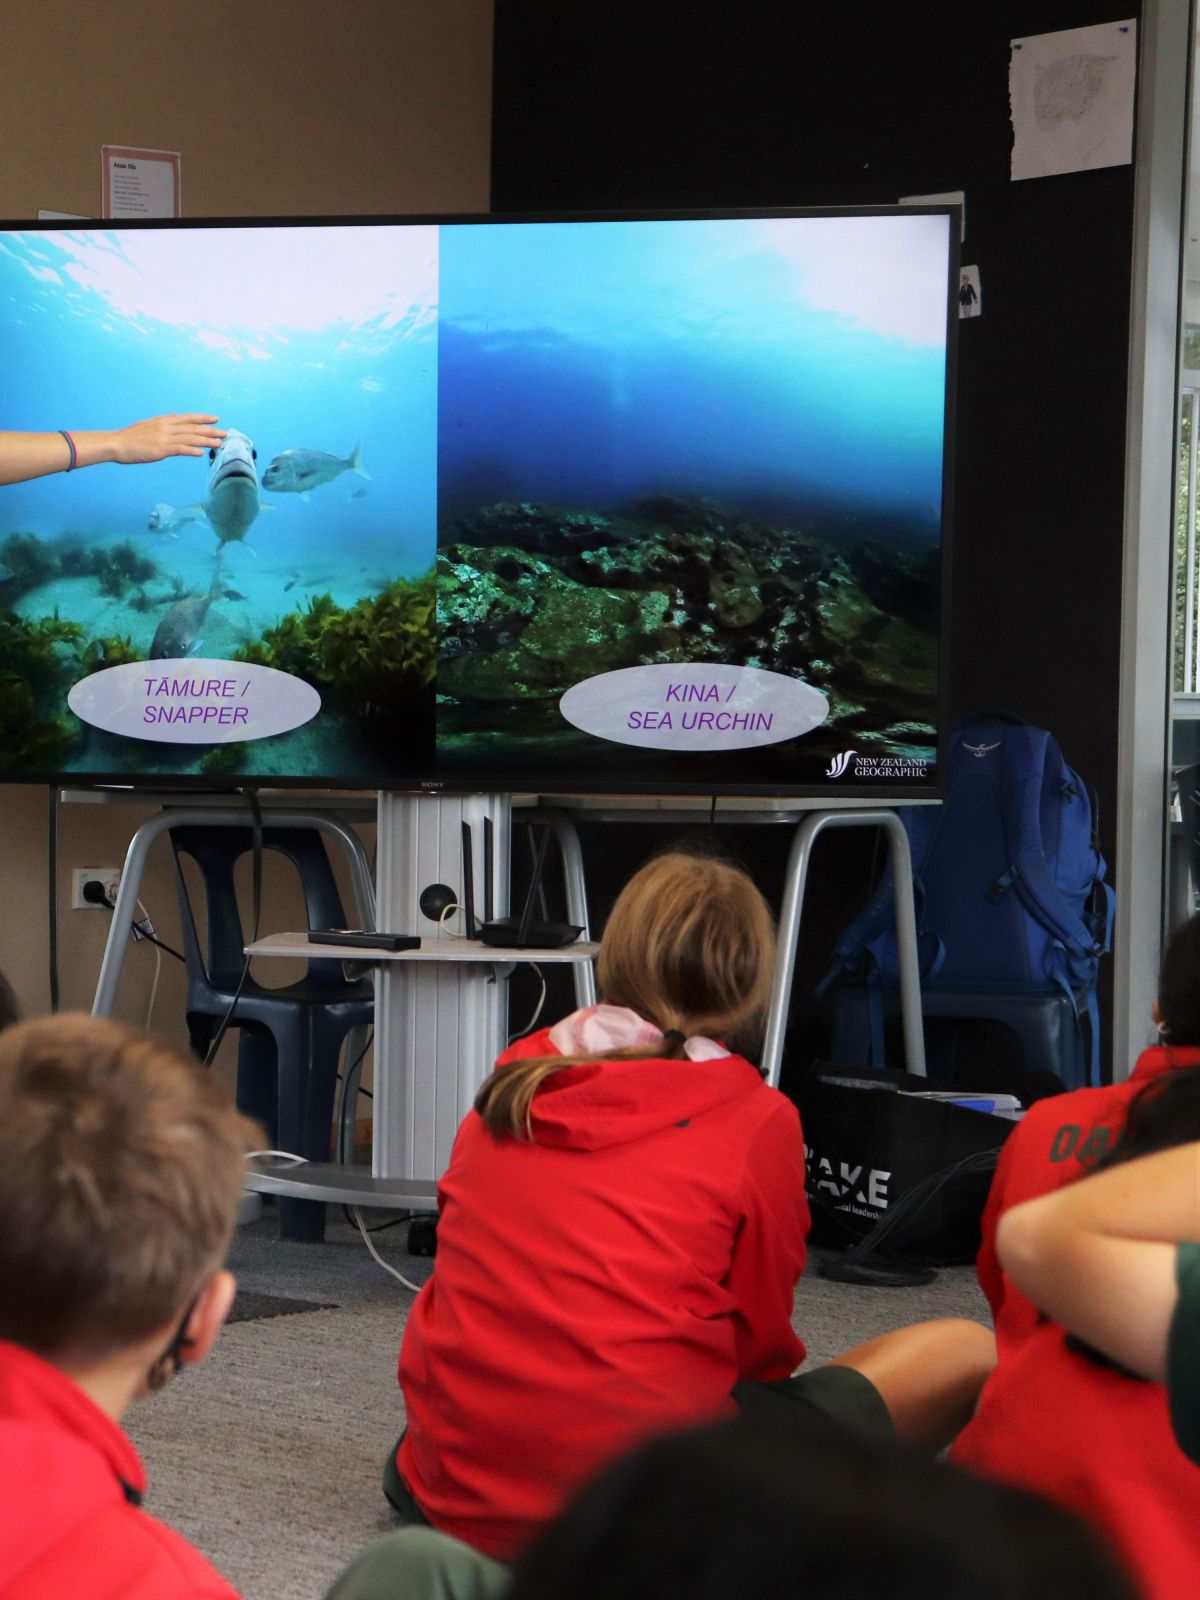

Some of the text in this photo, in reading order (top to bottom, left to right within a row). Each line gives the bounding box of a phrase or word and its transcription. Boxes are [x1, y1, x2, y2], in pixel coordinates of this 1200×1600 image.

[144, 677, 251, 697] TĀMURE /
[666, 684, 736, 702] KINA /
[143, 706, 249, 724] SNAPPER
[627, 711, 774, 731] SEA URCHIN
[856, 757, 927, 767] NEW ZEALAND
[854, 766, 927, 777] GEOGRAPHIC
